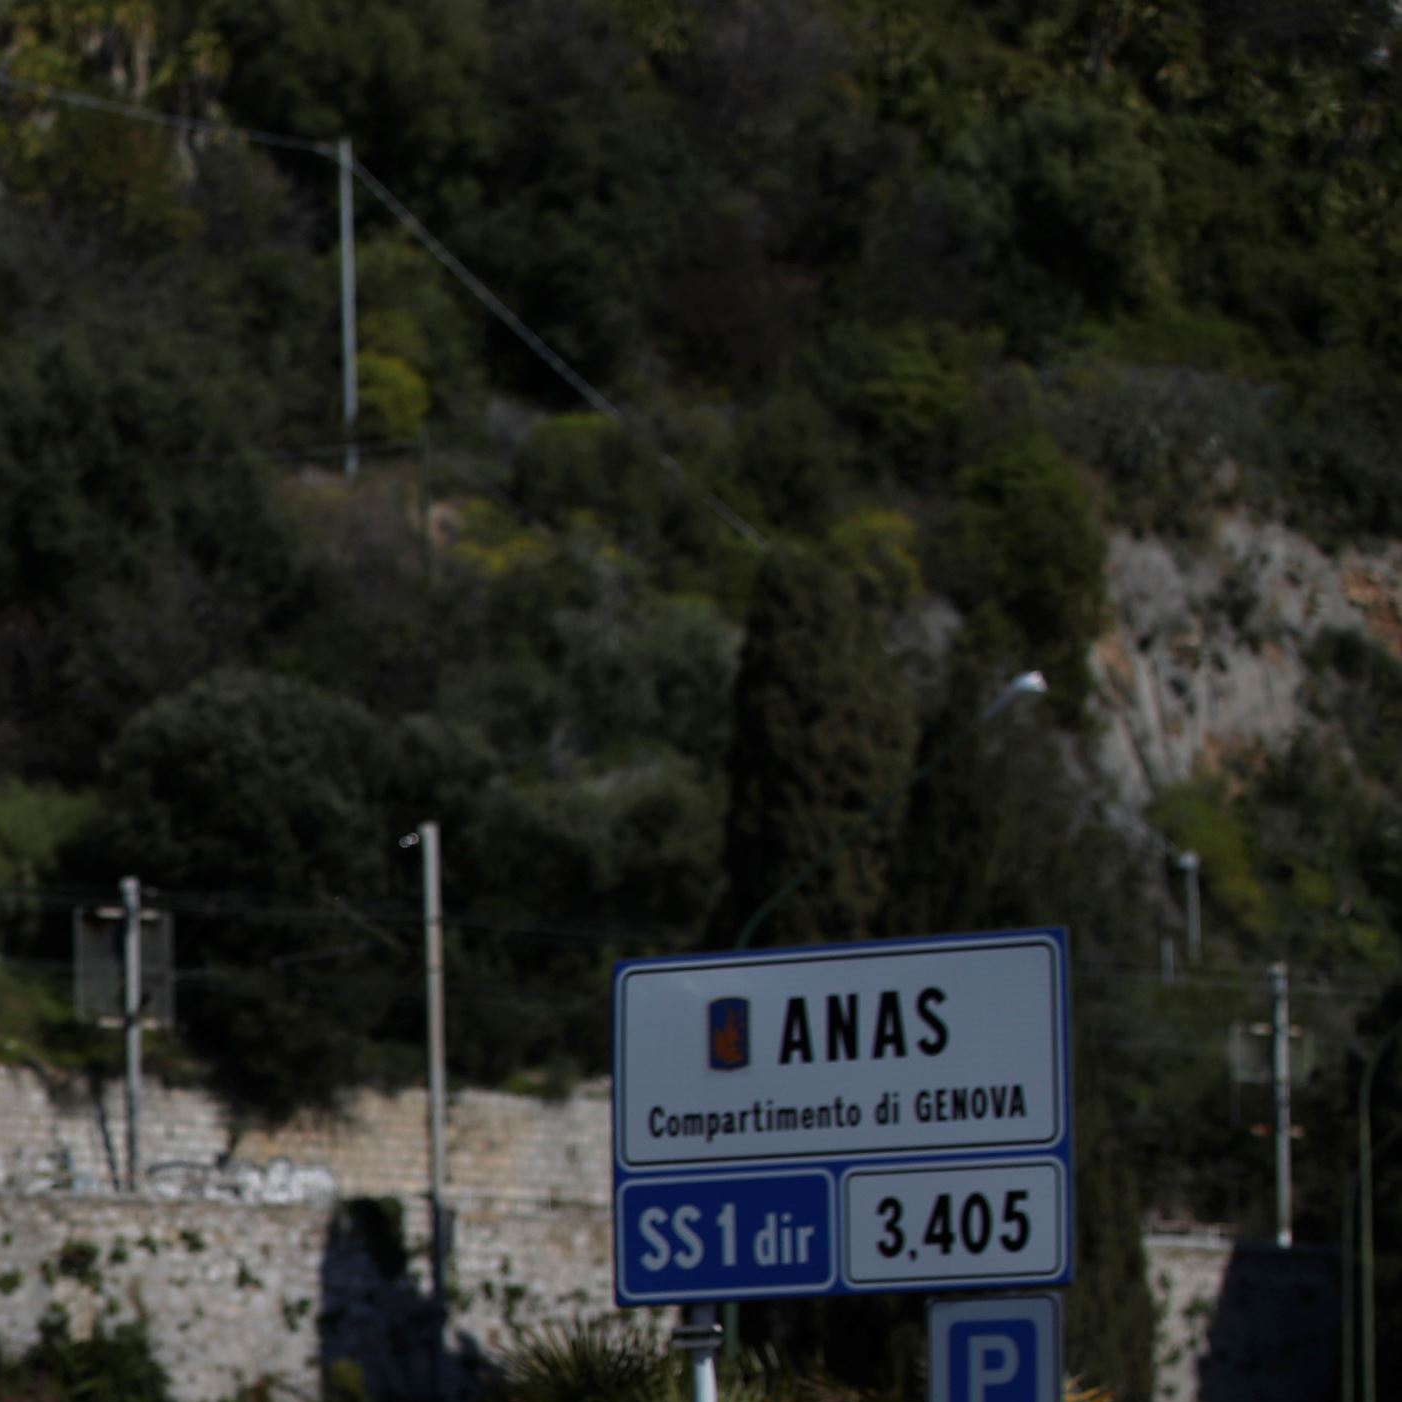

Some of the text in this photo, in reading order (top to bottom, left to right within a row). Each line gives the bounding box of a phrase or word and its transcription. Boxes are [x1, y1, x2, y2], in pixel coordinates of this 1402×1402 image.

[778, 986, 949, 1065] ANAS
[648, 1084, 1027, 1143] Compartimento di GENOVA
[753, 1212, 815, 1267] dir
